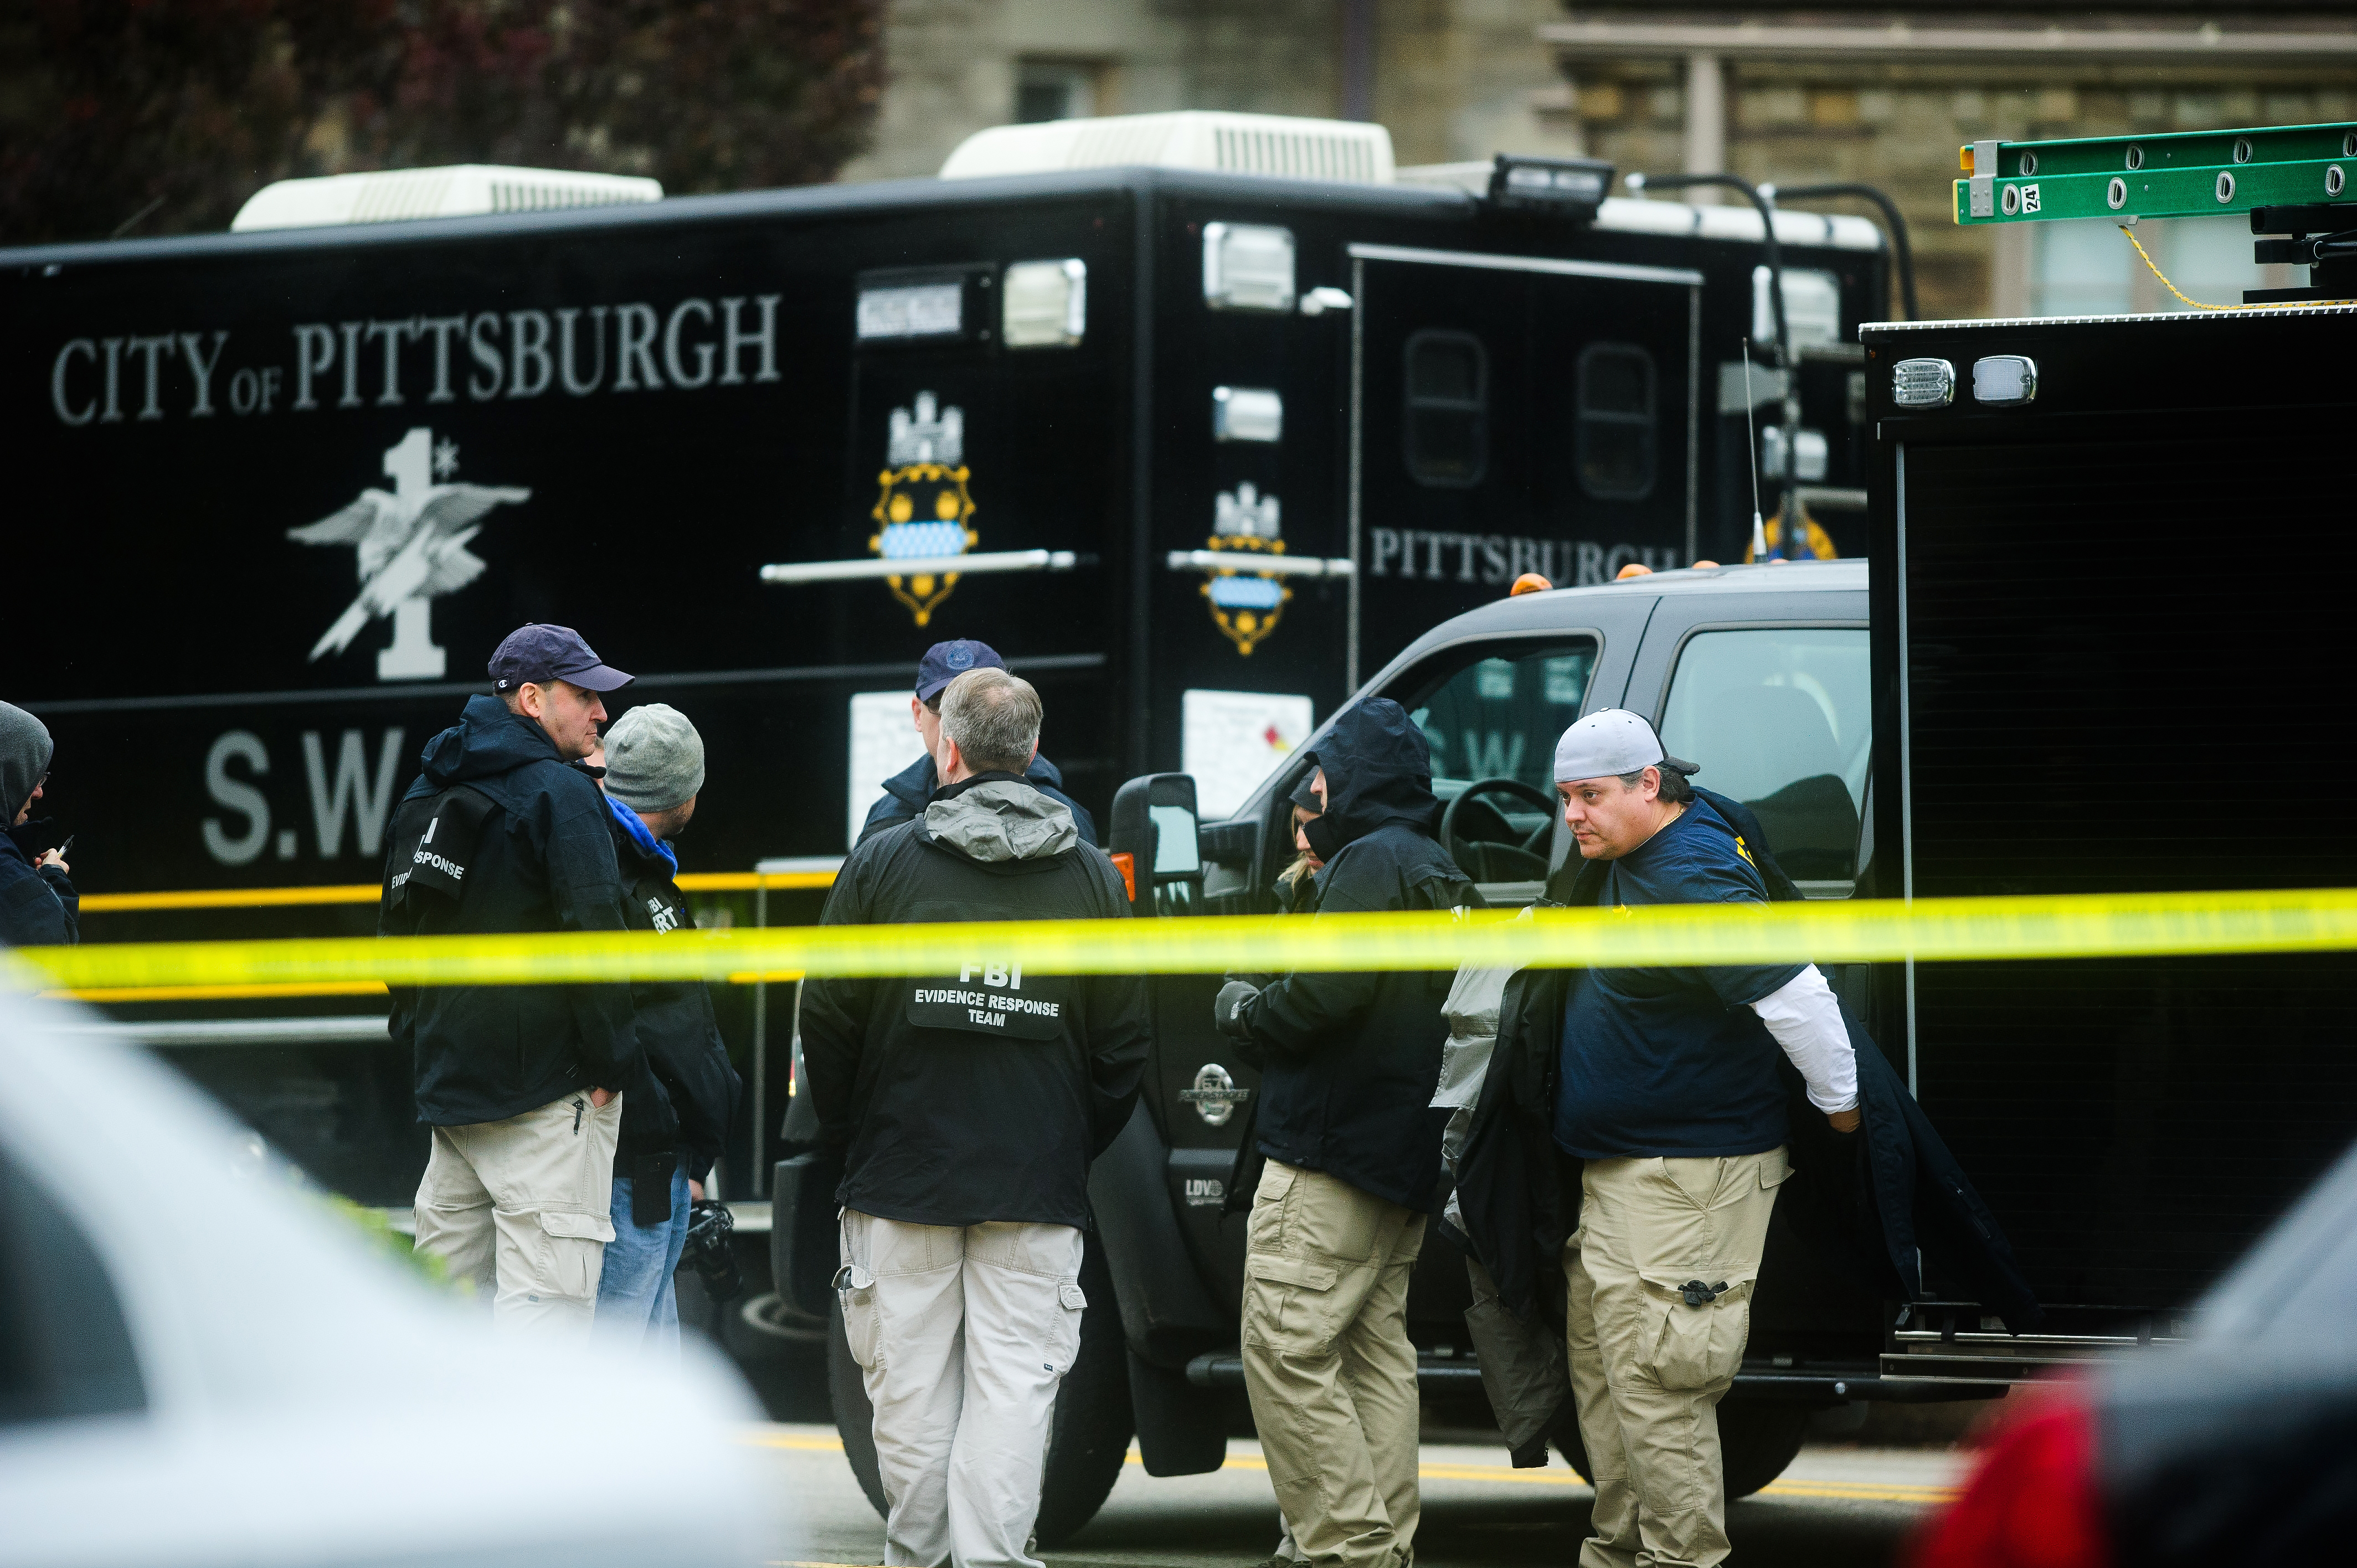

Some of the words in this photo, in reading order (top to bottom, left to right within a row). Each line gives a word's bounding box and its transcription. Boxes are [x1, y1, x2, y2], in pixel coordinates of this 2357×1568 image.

[52, 332, 228, 425] CITY
[230, 368, 281, 414] OF
[293, 293, 783, 410] PITTSBURGH
[415, 851, 464, 880] SPONSE
[959, 960, 1023, 990] FBI
[915, 989, 985, 1007] EVIDENCE
[988, 994, 1059, 1017] RESPONSE
[968, 1009, 1006, 1027] TEAM
